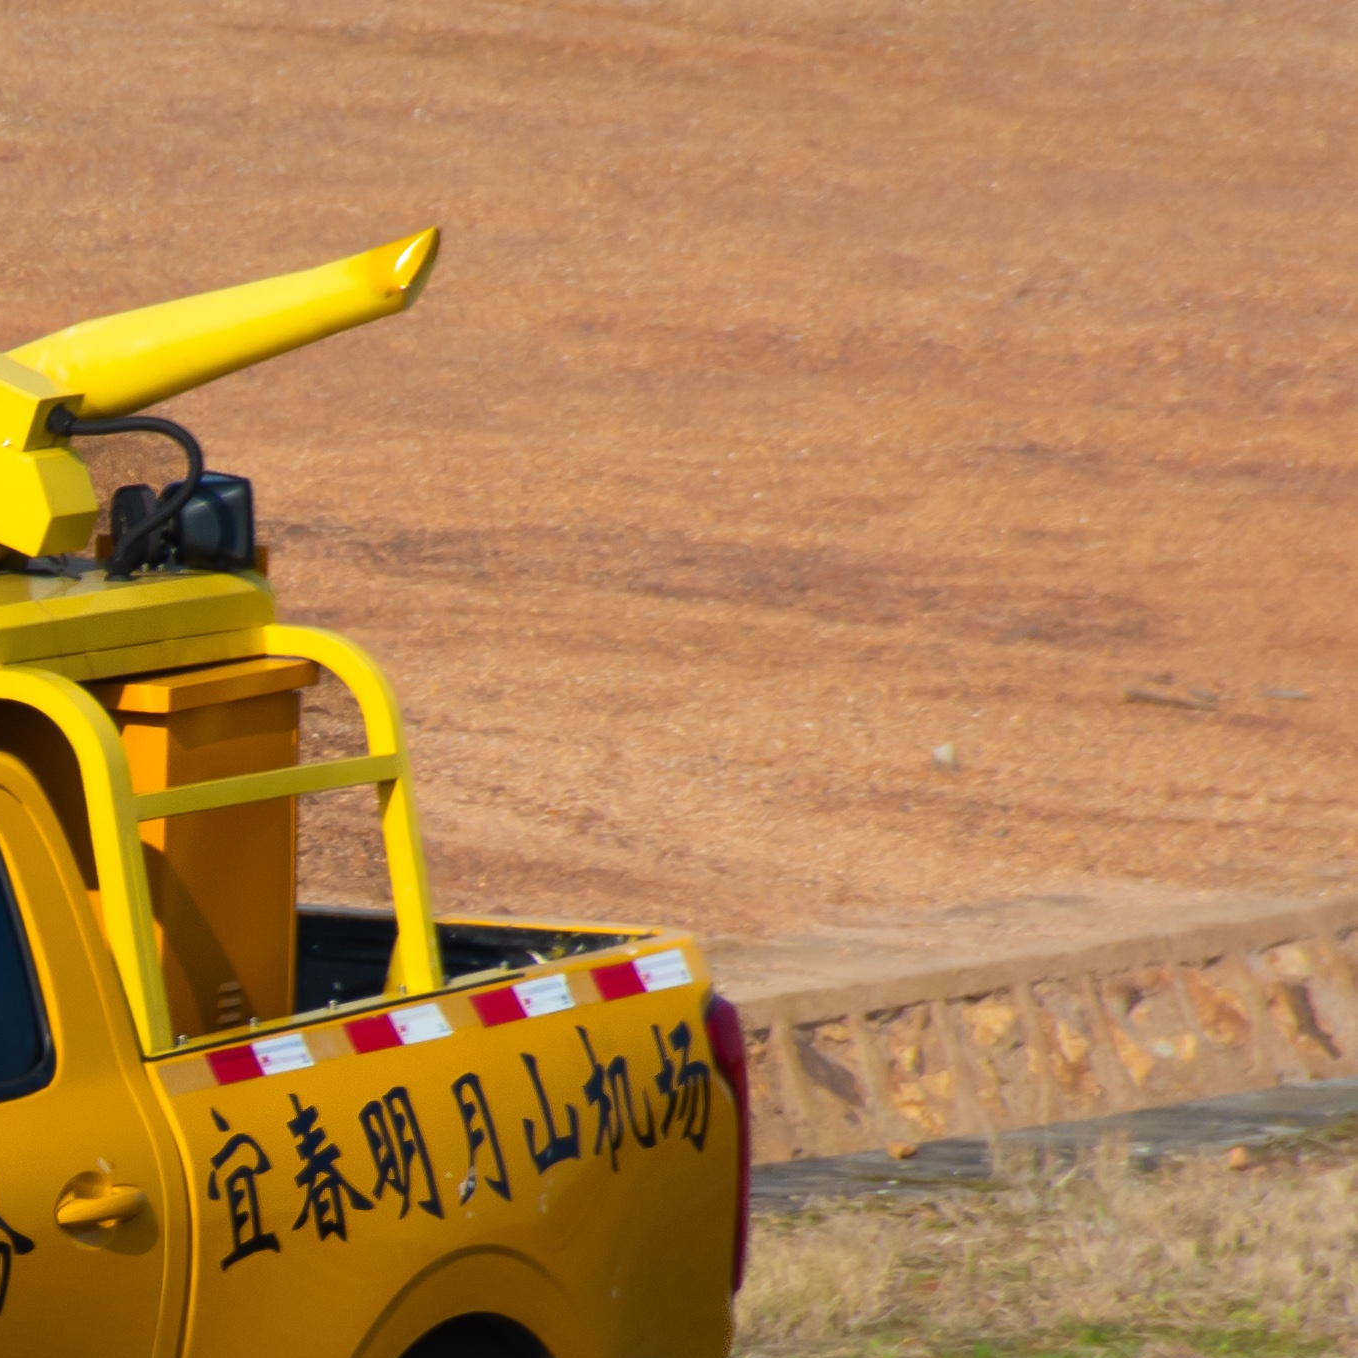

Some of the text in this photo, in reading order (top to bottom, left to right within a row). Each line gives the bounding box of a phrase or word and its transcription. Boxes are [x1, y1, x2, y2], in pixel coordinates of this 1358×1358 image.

[207, 1020, 711, 1271] 宜春明月山机场
